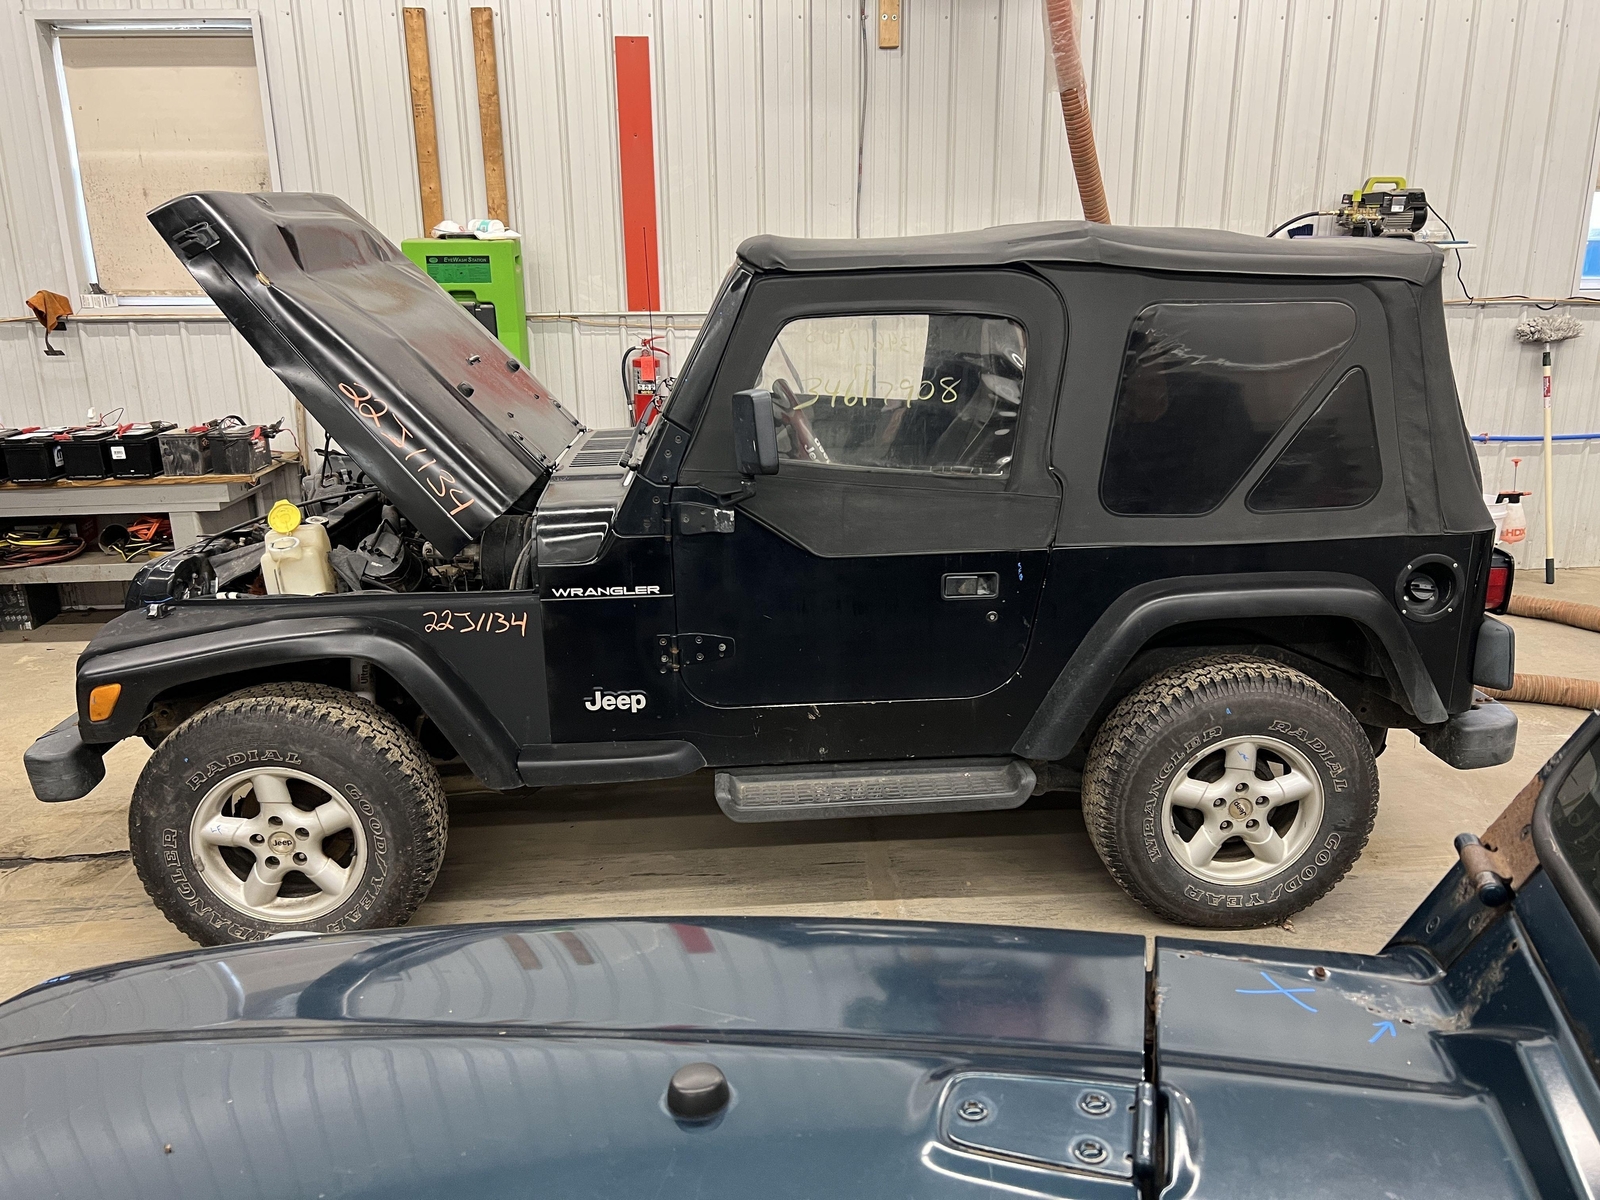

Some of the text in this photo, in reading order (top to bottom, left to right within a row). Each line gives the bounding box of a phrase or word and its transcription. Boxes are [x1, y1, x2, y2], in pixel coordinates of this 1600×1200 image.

[793, 375, 962, 412] 34617908
[338, 382, 475, 516] 22J1134
[1505, 528, 1526, 537] HDX
[552, 585, 661, 598] WRANGLER
[422, 608, 528, 638] 22J1134
[584, 690, 647, 713] Jeep
[185, 749, 303, 792] RADIAL
[1268, 719, 1348, 794] RADIAL
[1142, 725, 1223, 863] WRANGLER
[1232, 800, 1248, 817] Jeep
[272, 839, 293, 847] Jeep
[325, 782, 390, 934] GOODYEAR
[1183, 832, 1342, 909] GOODYEAR
